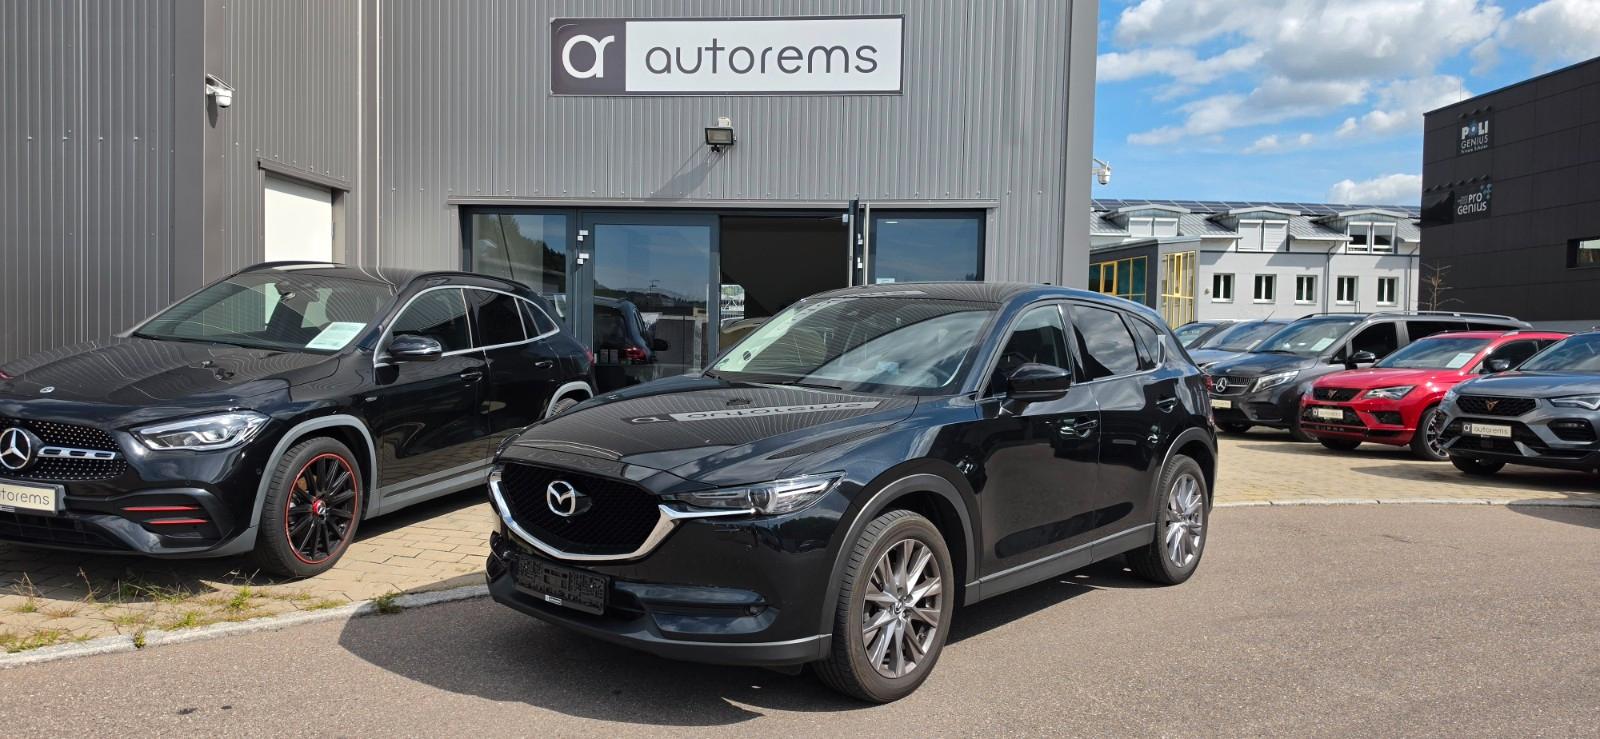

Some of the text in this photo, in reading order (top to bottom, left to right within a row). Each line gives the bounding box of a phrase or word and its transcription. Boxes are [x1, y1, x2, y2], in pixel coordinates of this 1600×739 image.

[645, 38, 878, 75] autorems
[1460, 134, 1489, 149] GENIUS
[0, 487, 50, 506] torems
